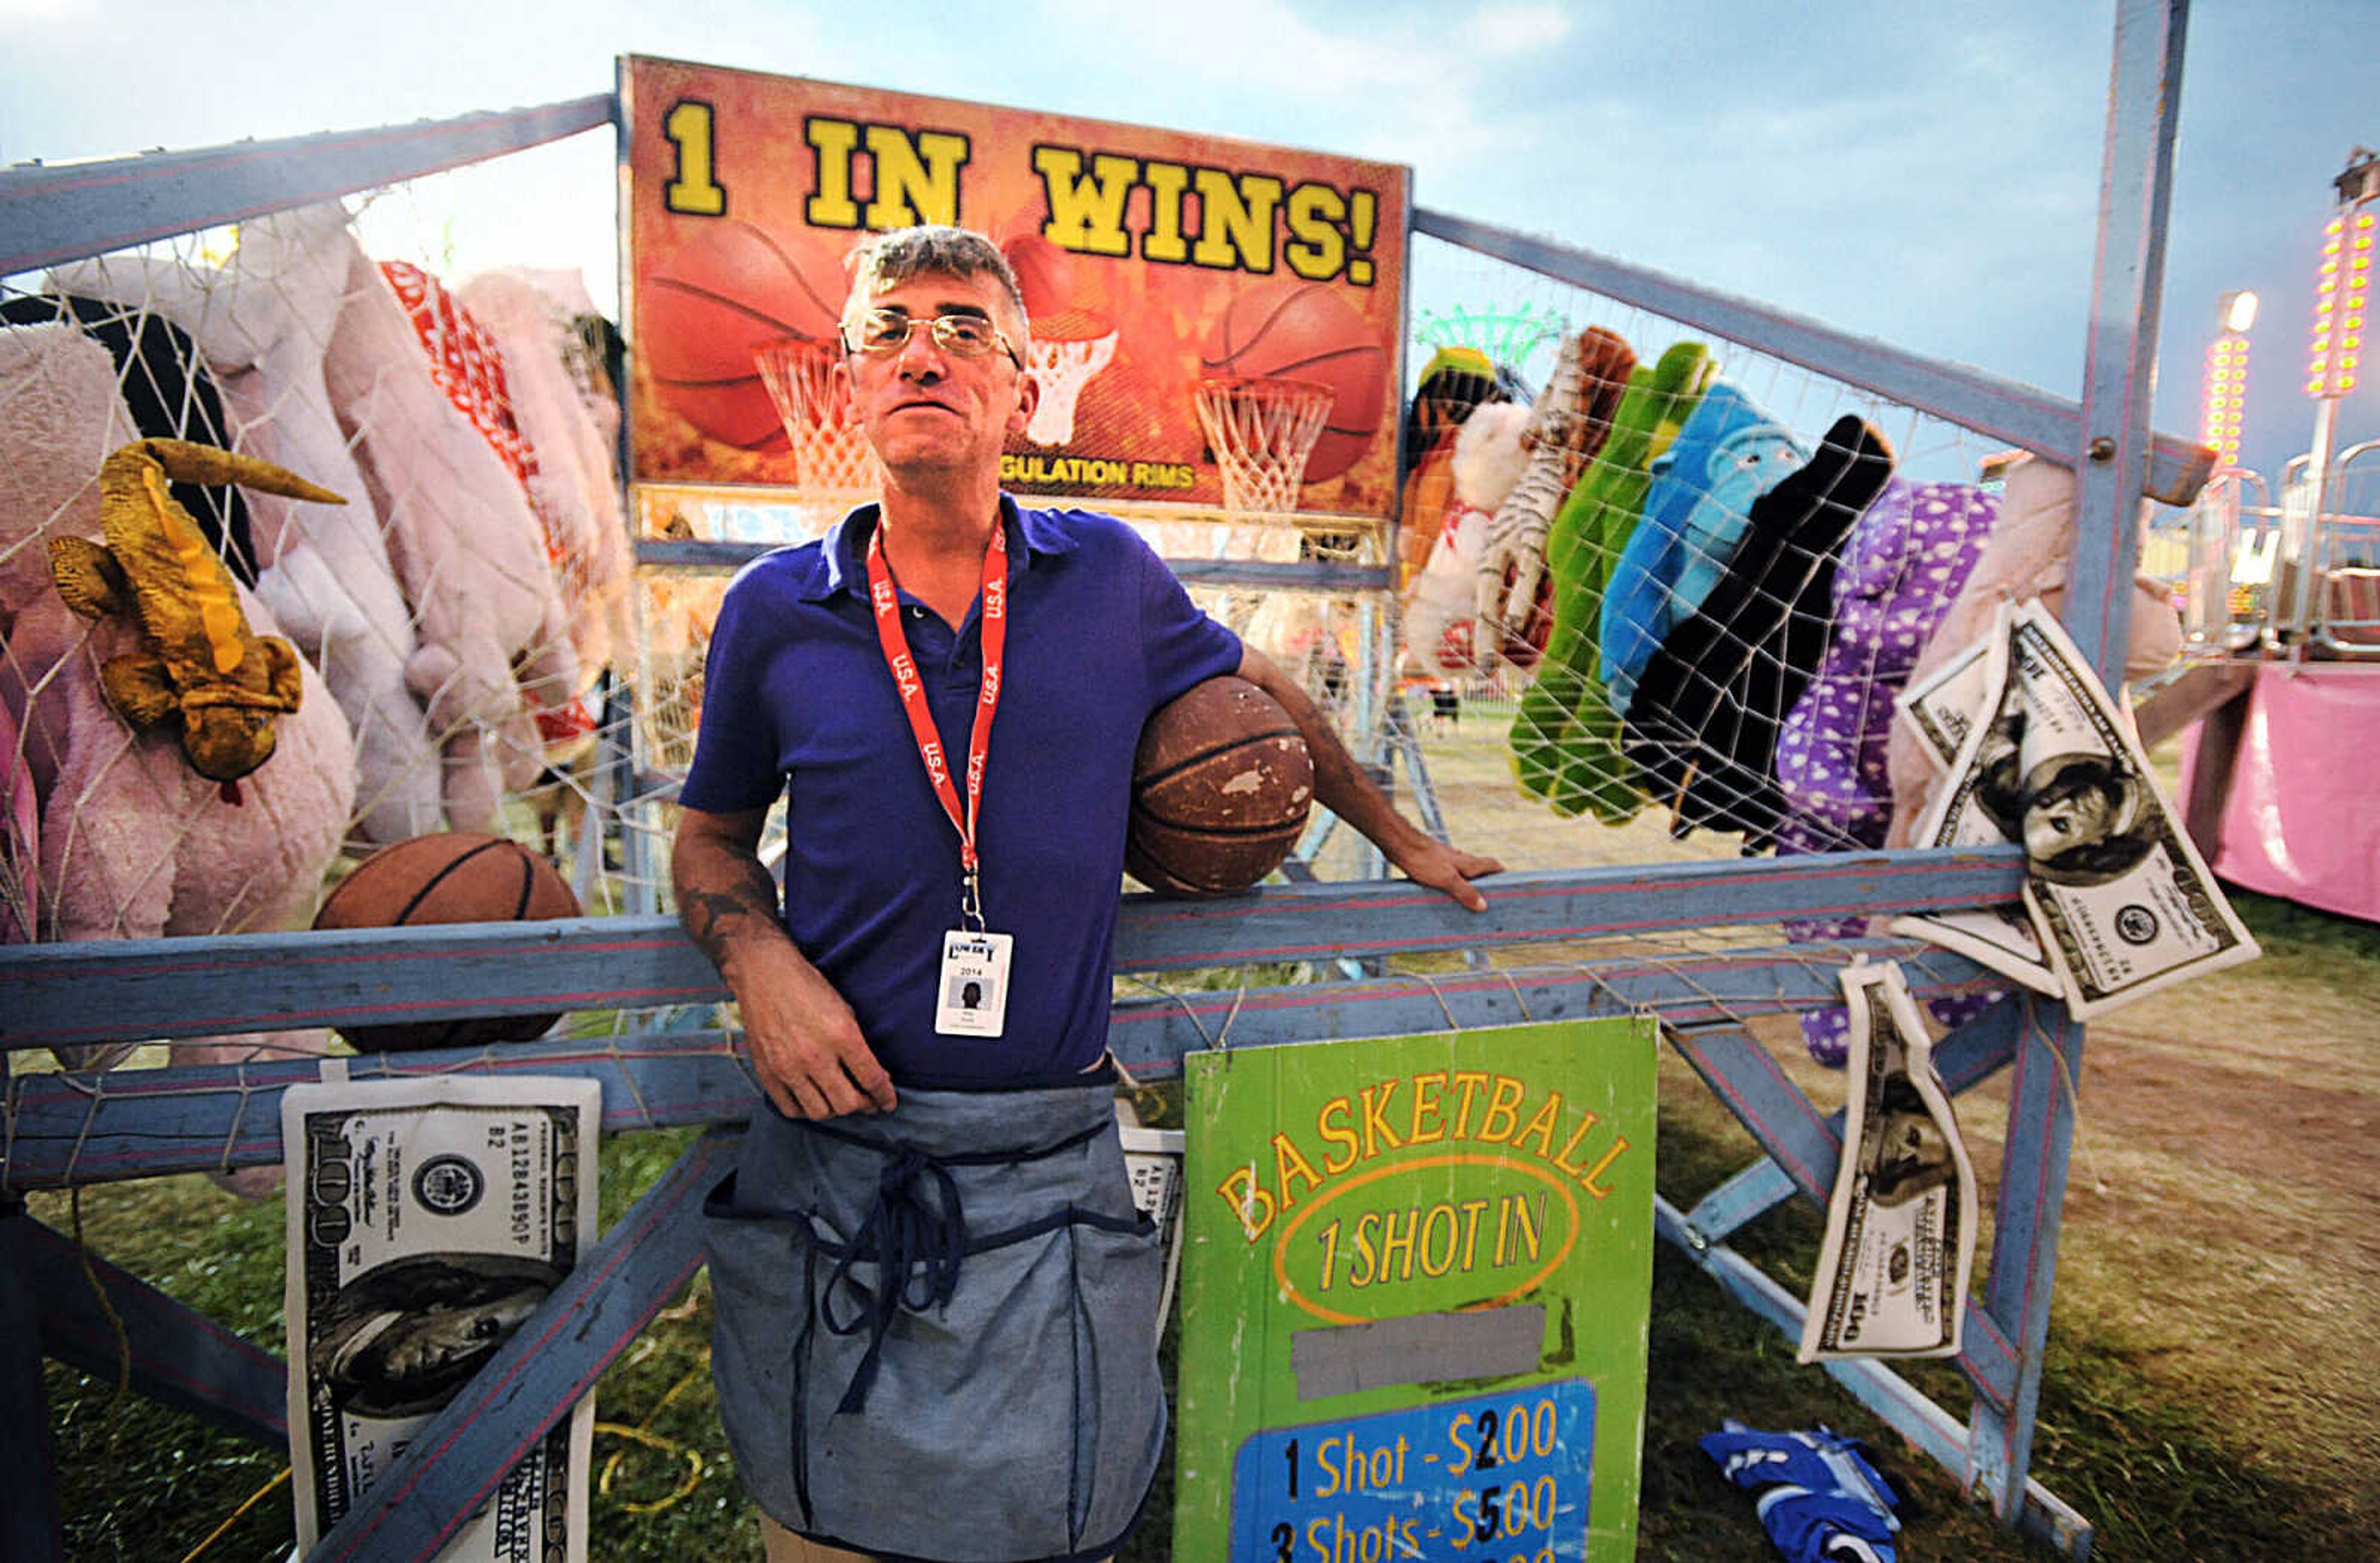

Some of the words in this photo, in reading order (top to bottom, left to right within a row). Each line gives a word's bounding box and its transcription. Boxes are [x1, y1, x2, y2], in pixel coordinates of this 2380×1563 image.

[664, 97, 726, 216] 1
[804, 114, 969, 232] IN
[1033, 144, 1378, 286] WINS!
[1000, 455, 1127, 485] GULATION
[1132, 463, 1194, 488] RIMS
[1217, 1070, 1630, 1244] BASKETBALL
[1318, 1219, 1341, 1291] 1
[1349, 1200, 1488, 1288] SHOT
[1492, 1191, 1547, 1267] IN
[1285, 1438, 1298, 1502] 1
[1315, 1432, 1409, 1498] Shot
[1447, 1400, 1557, 1476] $2.00
[1272, 1522, 1296, 1563] 3
[1307, 1512, 1420, 1563] Shots
[1452, 1475, 1557, 1550] $5.00
